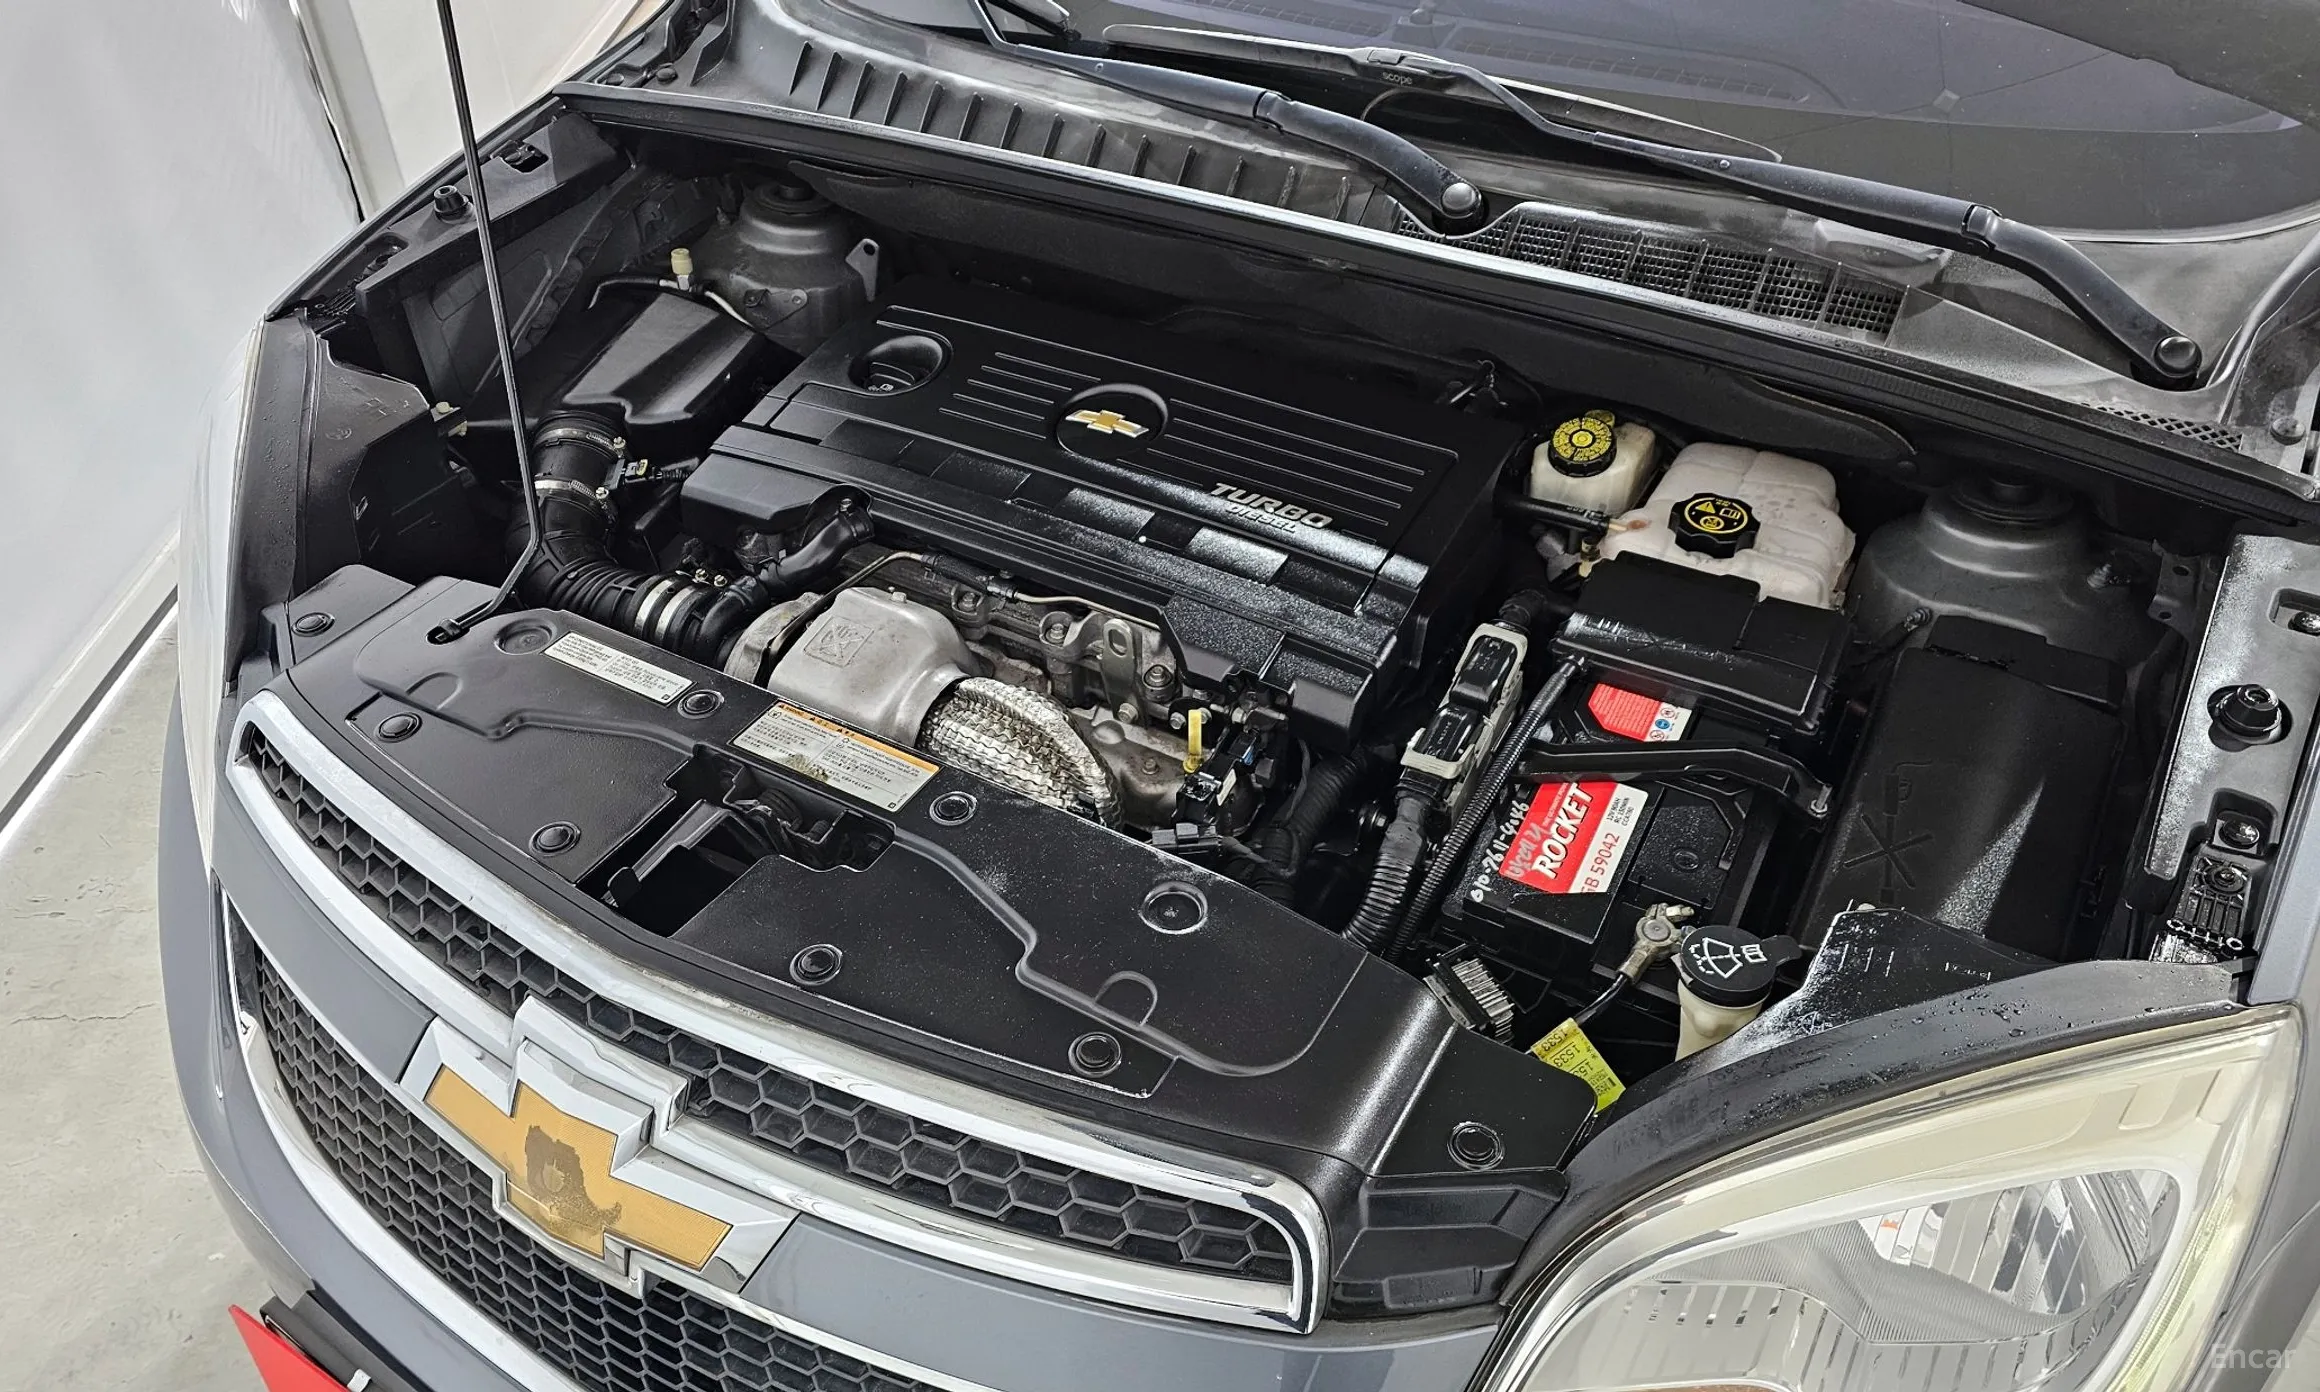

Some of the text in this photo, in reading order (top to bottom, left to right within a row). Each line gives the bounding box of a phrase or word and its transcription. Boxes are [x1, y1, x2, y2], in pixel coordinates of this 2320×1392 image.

[1210, 482, 1333, 529] TURBO
[1225, 503, 1296, 534] DIESEL
[1530, 782, 1594, 880] ROCKET
[1590, 832, 1620, 876] 59042
[1541, 1029, 1567, 1052] 1533
[1553, 1044, 1580, 1067] 1533
